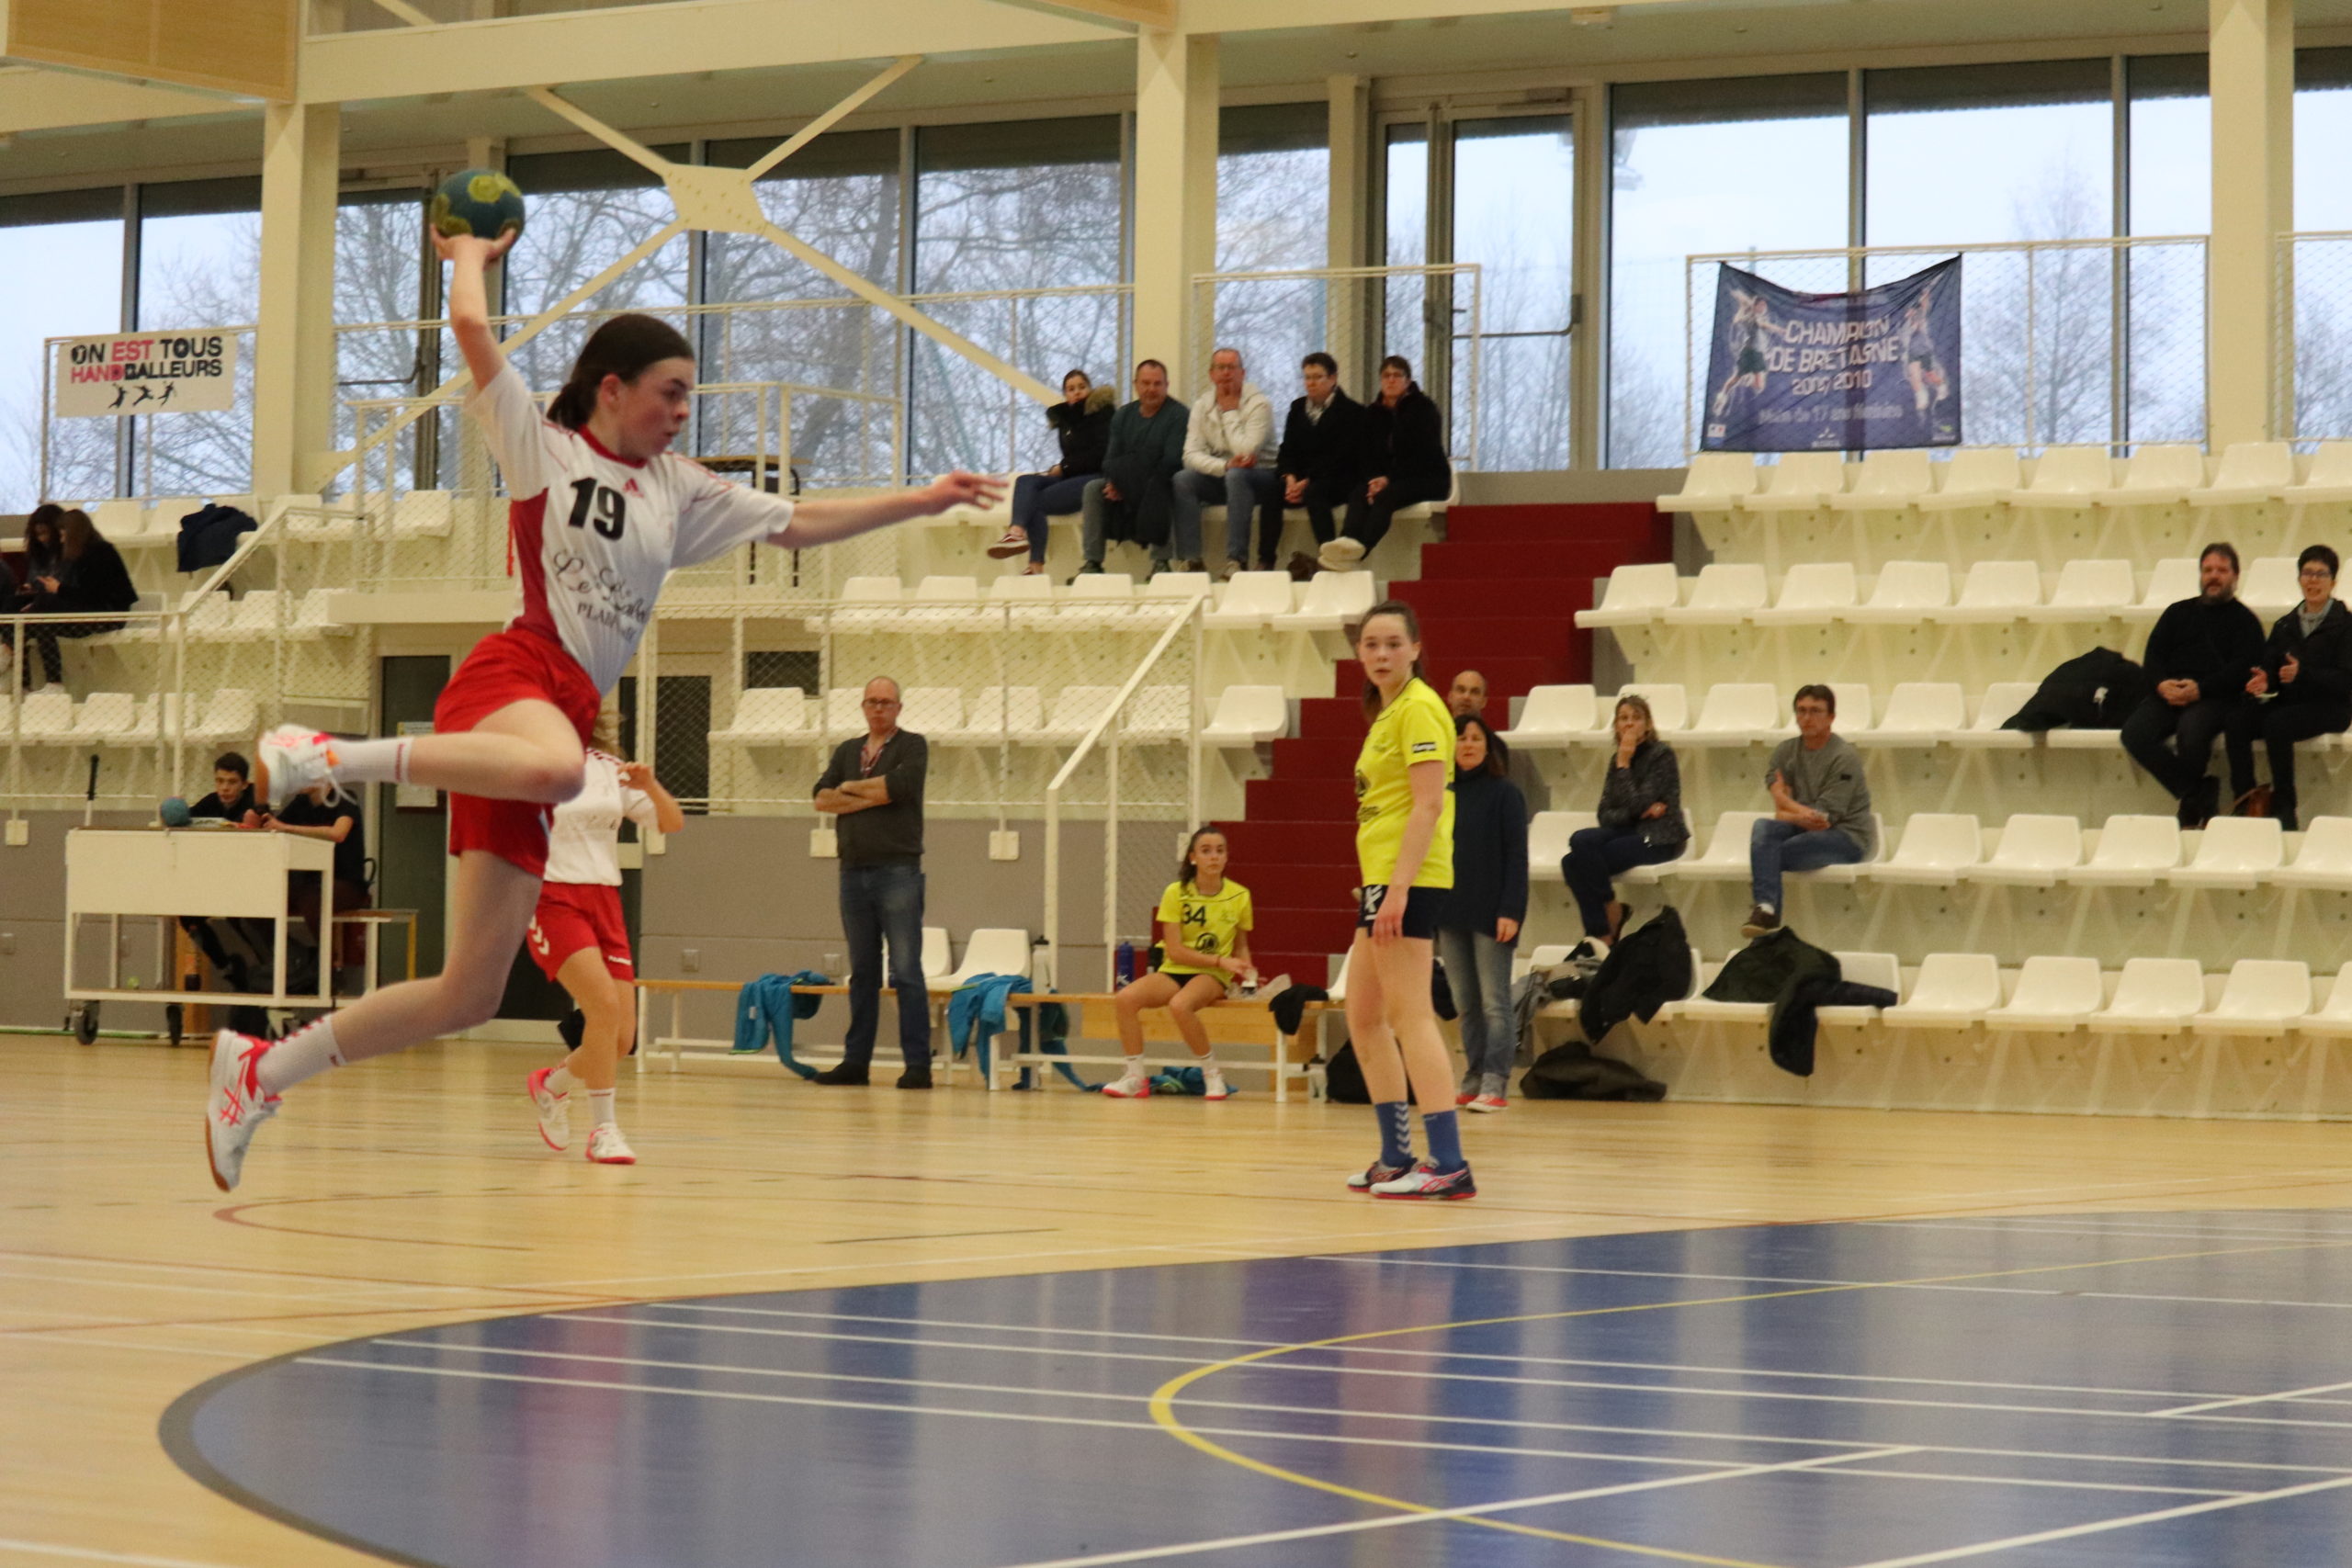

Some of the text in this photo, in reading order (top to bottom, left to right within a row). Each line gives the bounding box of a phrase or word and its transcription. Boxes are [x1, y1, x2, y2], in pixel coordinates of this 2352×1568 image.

[1784, 315, 1891, 345] CHAMPION
[71, 336, 222, 365] ON EST TOUS
[1767, 336, 1900, 373] DE BRETAGNE
[71, 359, 223, 383] HANDBALLEURS
[567, 477, 626, 542] 19
[1182, 903, 1206, 928] 34
